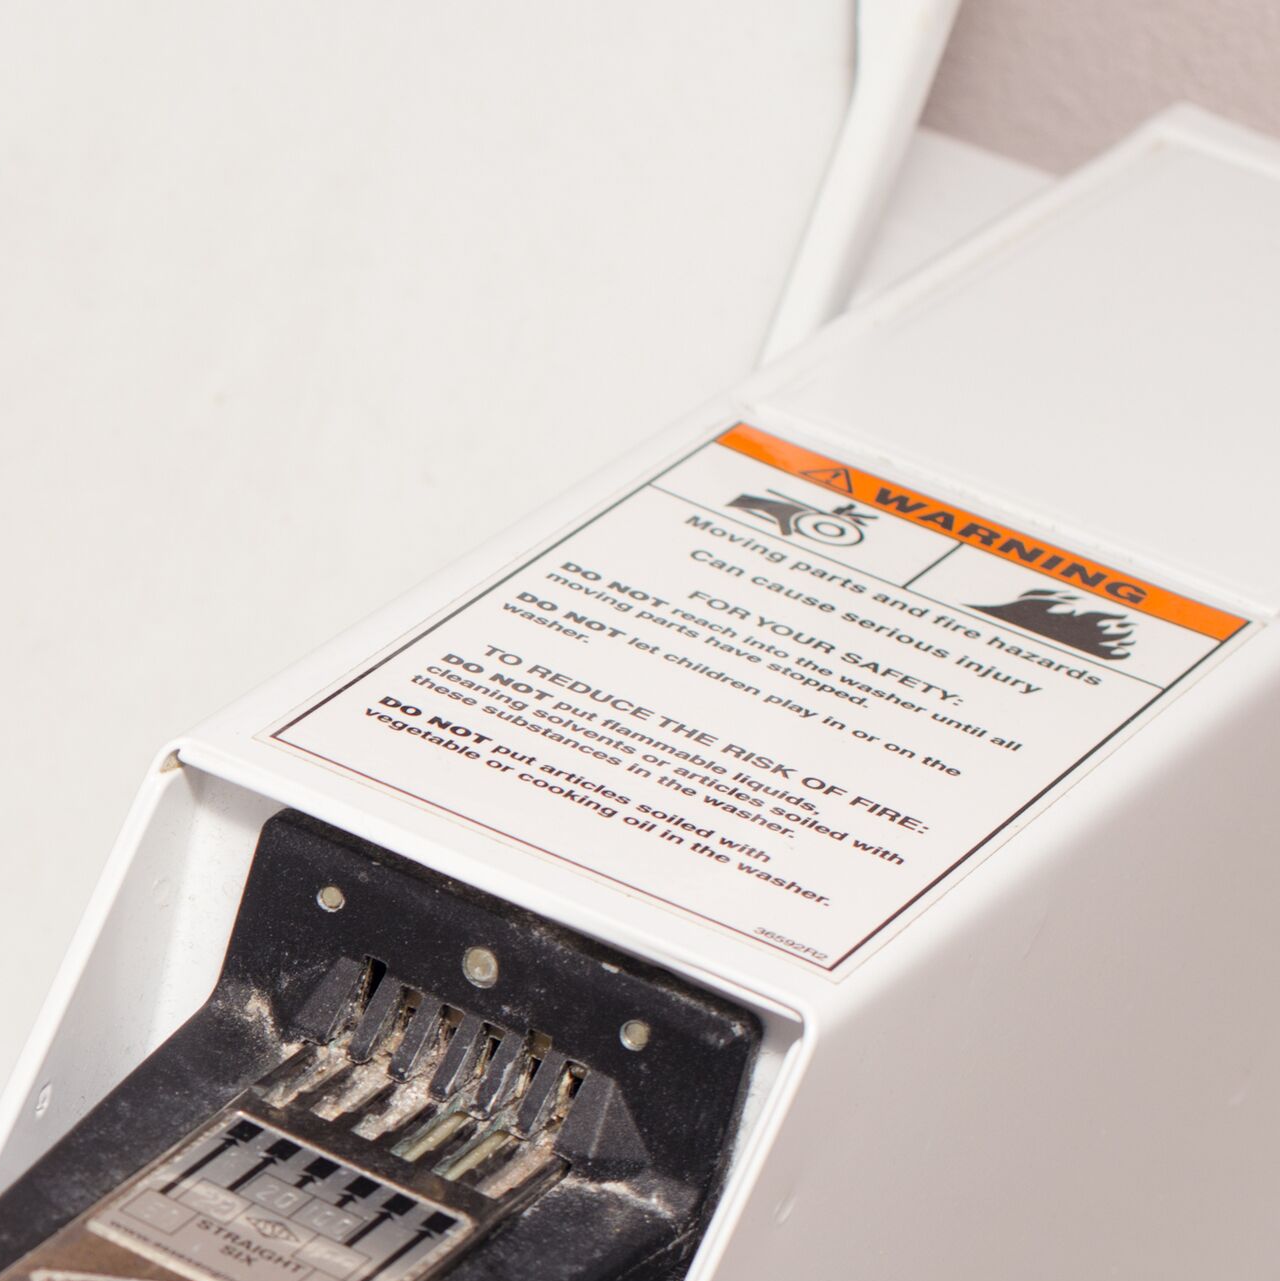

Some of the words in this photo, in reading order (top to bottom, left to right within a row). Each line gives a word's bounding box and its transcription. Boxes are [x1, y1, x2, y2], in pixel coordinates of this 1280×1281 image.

[502, 602, 589, 643] washer.
[685, 515, 787, 563] Moving
[789, 561, 866, 593] parts
[871, 593, 929, 618] and
[932, 615, 981, 638] fire
[986, 636, 1101, 685] hazards
[690, 550, 744, 576] Can
[751, 576, 835, 612] cause
[841, 612, 949, 658] serious
[955, 655, 1042, 694] injury
[875, 487, 1147, 605] WARNING
[516, 591, 558, 611] DO
[562, 611, 626, 637] NOT
[627, 637, 659, 654] let
[663, 653, 760, 695] children
[763, 694, 818, 718] play
[821, 715, 846, 730] in
[851, 729, 880, 742] or
[883, 742, 915, 758] on
[921, 756, 960, 776] the
[546, 572, 633, 612] moving
[634, 610, 699, 638] parts
[703, 636, 761, 663] have
[766, 663, 867, 708] stopped.
[560, 561, 601, 581] DO
[607, 581, 669, 607] NOT
[671, 608, 736, 637] reach
[742, 636, 789, 658] into
[794, 657, 832, 676] the
[839, 675, 926, 712] washer
[930, 712, 987, 737] until
[989, 737, 1022, 751] all
[687, 590, 750, 620] FOR
[757, 616, 835, 654] YOUR
[840, 652, 963, 705] SAFETY:
[365, 707, 480, 759] vegetable
[485, 759, 514, 772] or
[517, 773, 618, 818] cooking
[622, 816, 657, 832] oil
[659, 829, 684, 844] in
[690, 842, 730, 863] the
[737, 862, 829, 906] washer.
[378, 695, 422, 716] DO
[426, 715, 493, 743] NOT
[490, 744, 536, 765] put
[539, 764, 631, 804] articles
[635, 804, 715, 838] soiled
[719, 837, 770, 862] with
[410, 674, 477, 705] these
[481, 705, 622, 765] substances
[626, 762, 651, 777] in
[656, 775, 697, 796] the
[703, 795, 794, 838] washer.
[426, 665, 528, 711] cleaning
[532, 709, 636, 754] solvents
[641, 754, 670, 766] or
[673, 767, 764, 807] articles
[769, 806, 848, 841] soiled
[852, 839, 904, 865] with
[441, 653, 484, 673] DO
[488, 672, 554, 700] NOT
[551, 701, 597, 721] put
[600, 719, 727, 774] flammable
[731, 772, 819, 815] liquids,
[484, 644, 522, 665] TO
[526, 664, 654, 720] REDUCE
[658, 715, 718, 746] THE
[720, 743, 797, 779] RISK
[801, 776, 847, 795] OF
[848, 795, 928, 834] FIRE:
[196, 1219, 305, 1274] STRAIGHT
[220, 1245, 256, 1267] SIX
[256, 1183, 299, 1209] 20
